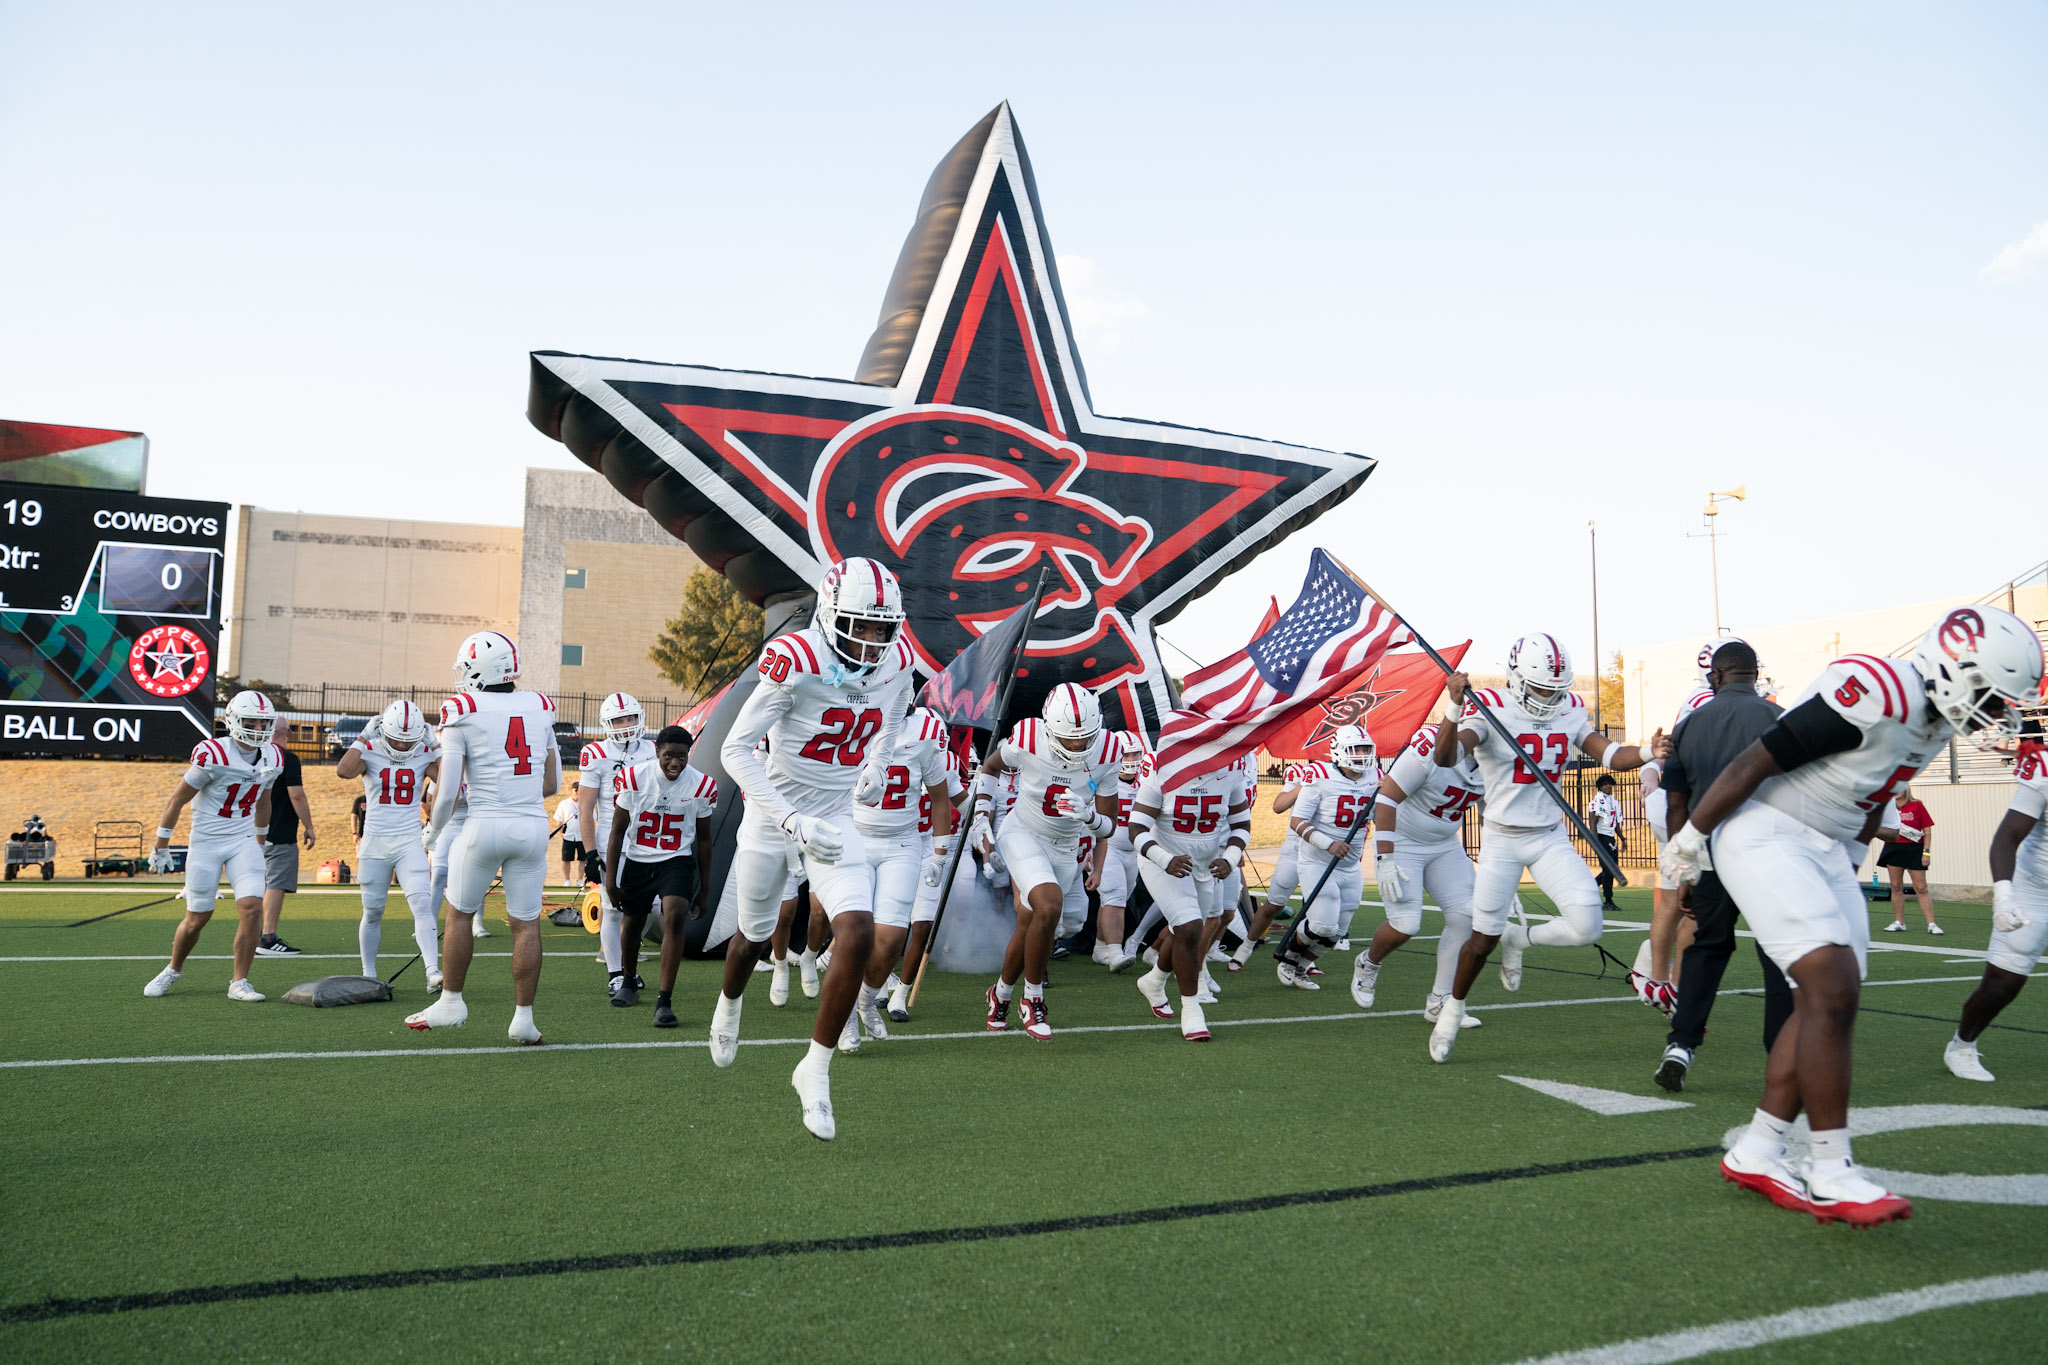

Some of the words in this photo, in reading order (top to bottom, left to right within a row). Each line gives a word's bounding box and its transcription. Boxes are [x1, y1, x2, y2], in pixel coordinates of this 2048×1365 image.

[3, 499, 42, 527] 19
[93, 509, 219, 536] COWBOYS
[161, 562, 183, 591] 0
[60, 594, 73, 611] 3
[132, 626, 207, 661] COPPELL
[758, 647, 793, 684] 20
[847, 694, 870, 705] COPPELL
[1834, 675, 1870, 708] 5
[3, 714, 85, 740] BALL
[93, 718, 141, 743] ON
[799, 706, 883, 767] 20
[1411, 731, 1434, 757] 75
[504, 716, 532, 776] 4
[1513, 733, 1569, 785] 23
[378, 767, 416, 806] 18
[1051, 775, 1072, 785] COPPELL
[217, 783, 263, 818] 14
[1172, 795, 1223, 834] 55
[636, 810, 685, 851] 25
